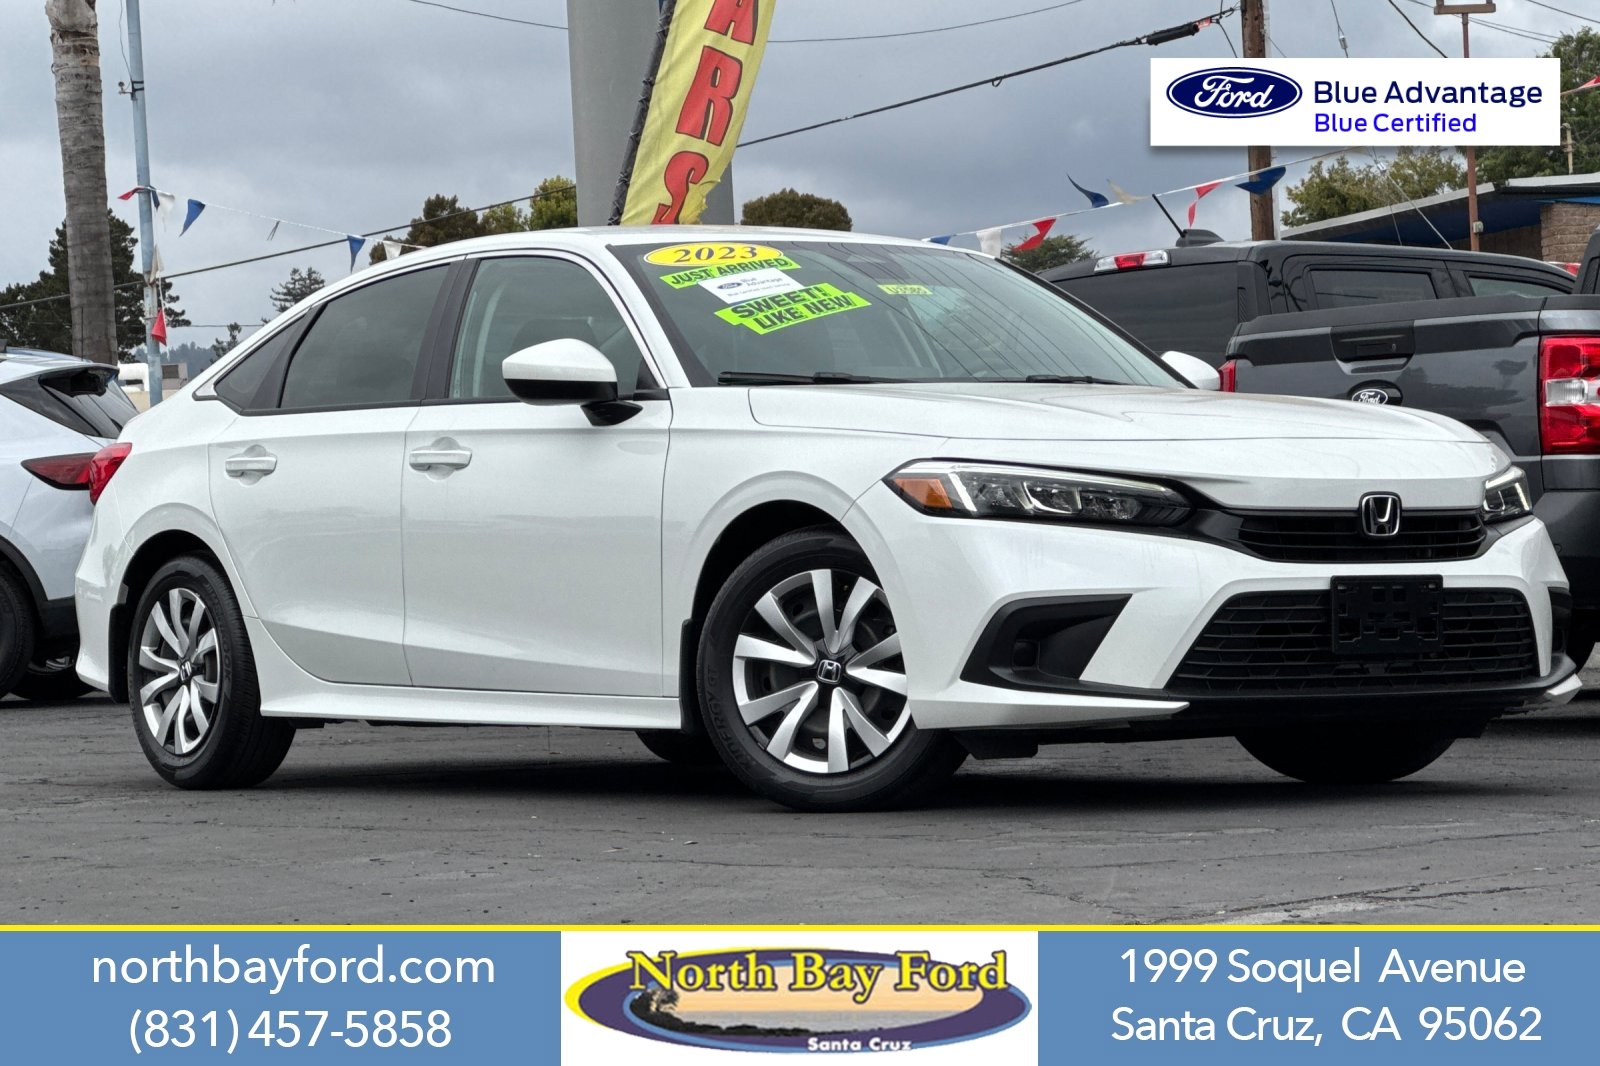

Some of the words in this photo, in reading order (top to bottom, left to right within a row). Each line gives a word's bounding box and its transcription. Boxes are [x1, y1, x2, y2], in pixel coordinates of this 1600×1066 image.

[673, 246, 758, 263] 2023
[671, 269, 712, 285] JUST
[717, 258, 789, 276] ARRIVED
[731, 286, 829, 318] SWEET!
[753, 307, 808, 329] LIKE
[803, 294, 856, 316] NEW
